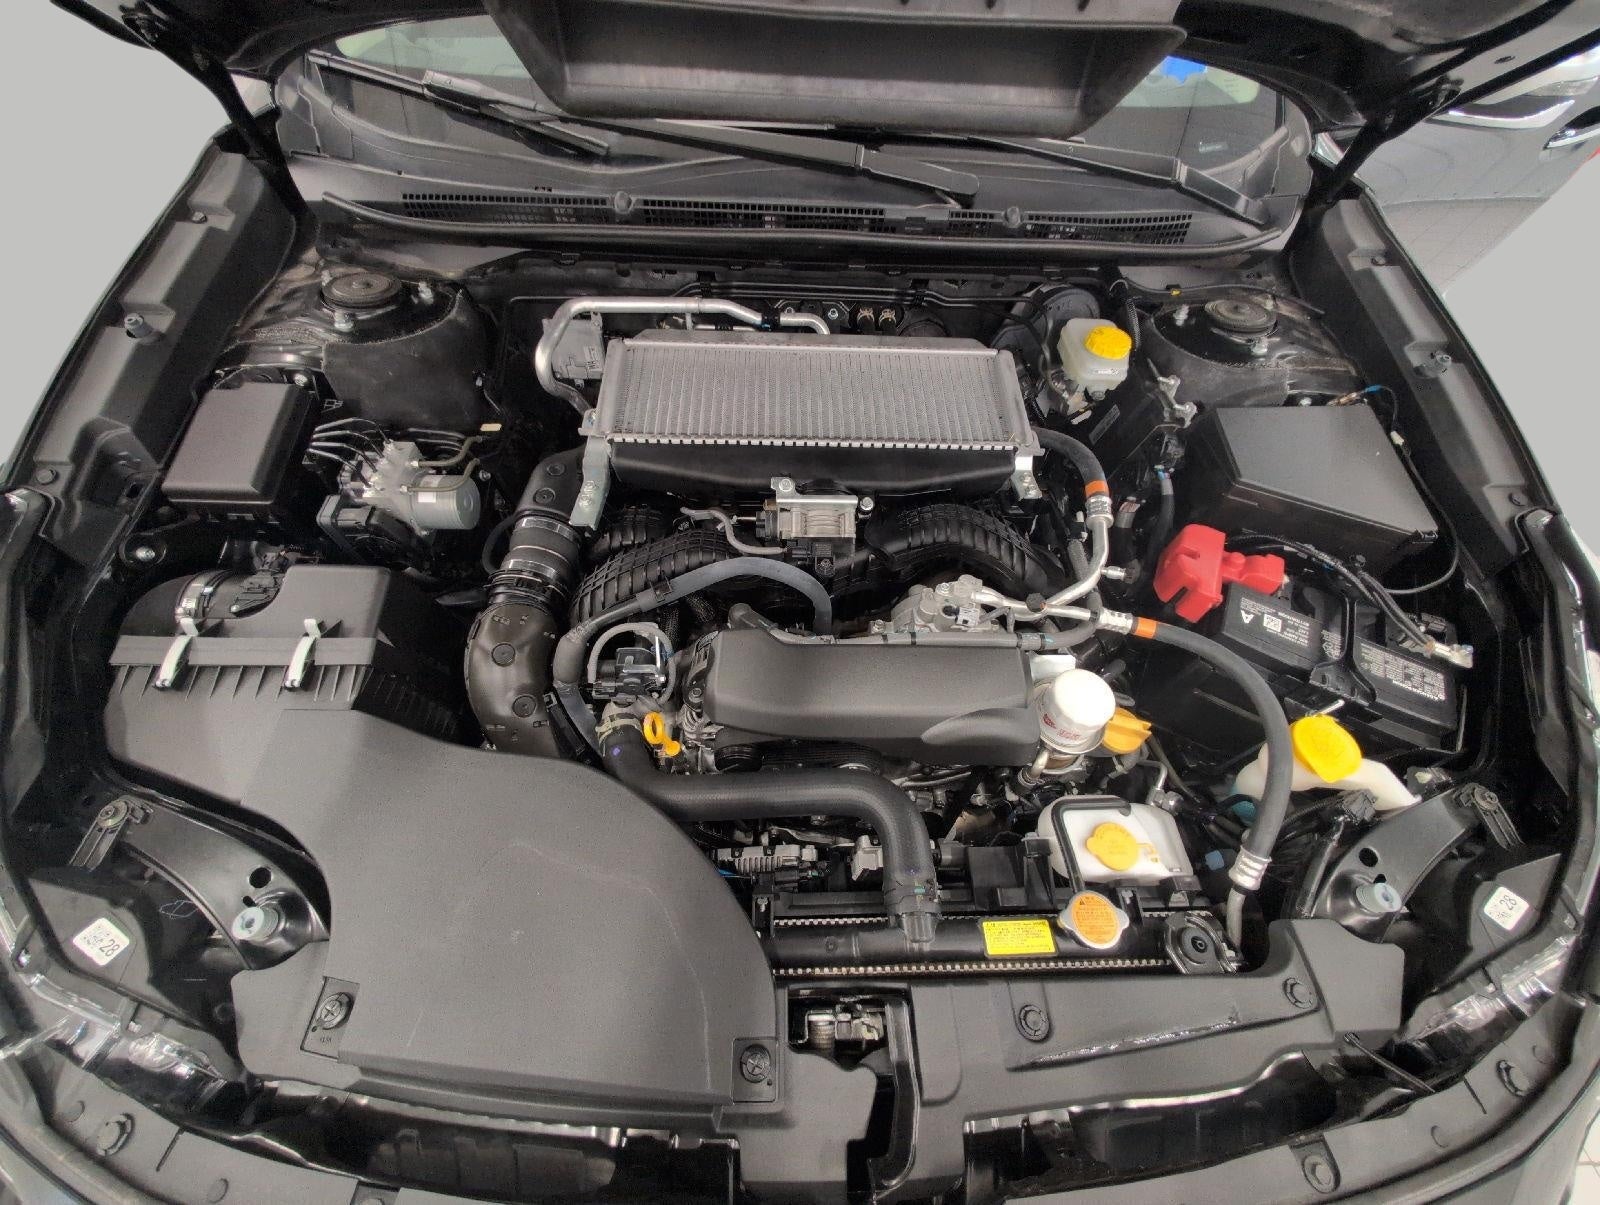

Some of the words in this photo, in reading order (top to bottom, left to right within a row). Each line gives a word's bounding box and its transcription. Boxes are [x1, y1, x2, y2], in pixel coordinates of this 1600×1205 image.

[1240, 610, 1254, 624] A
[1499, 894, 1517, 911] 28
[99, 938, 120, 957] 28
